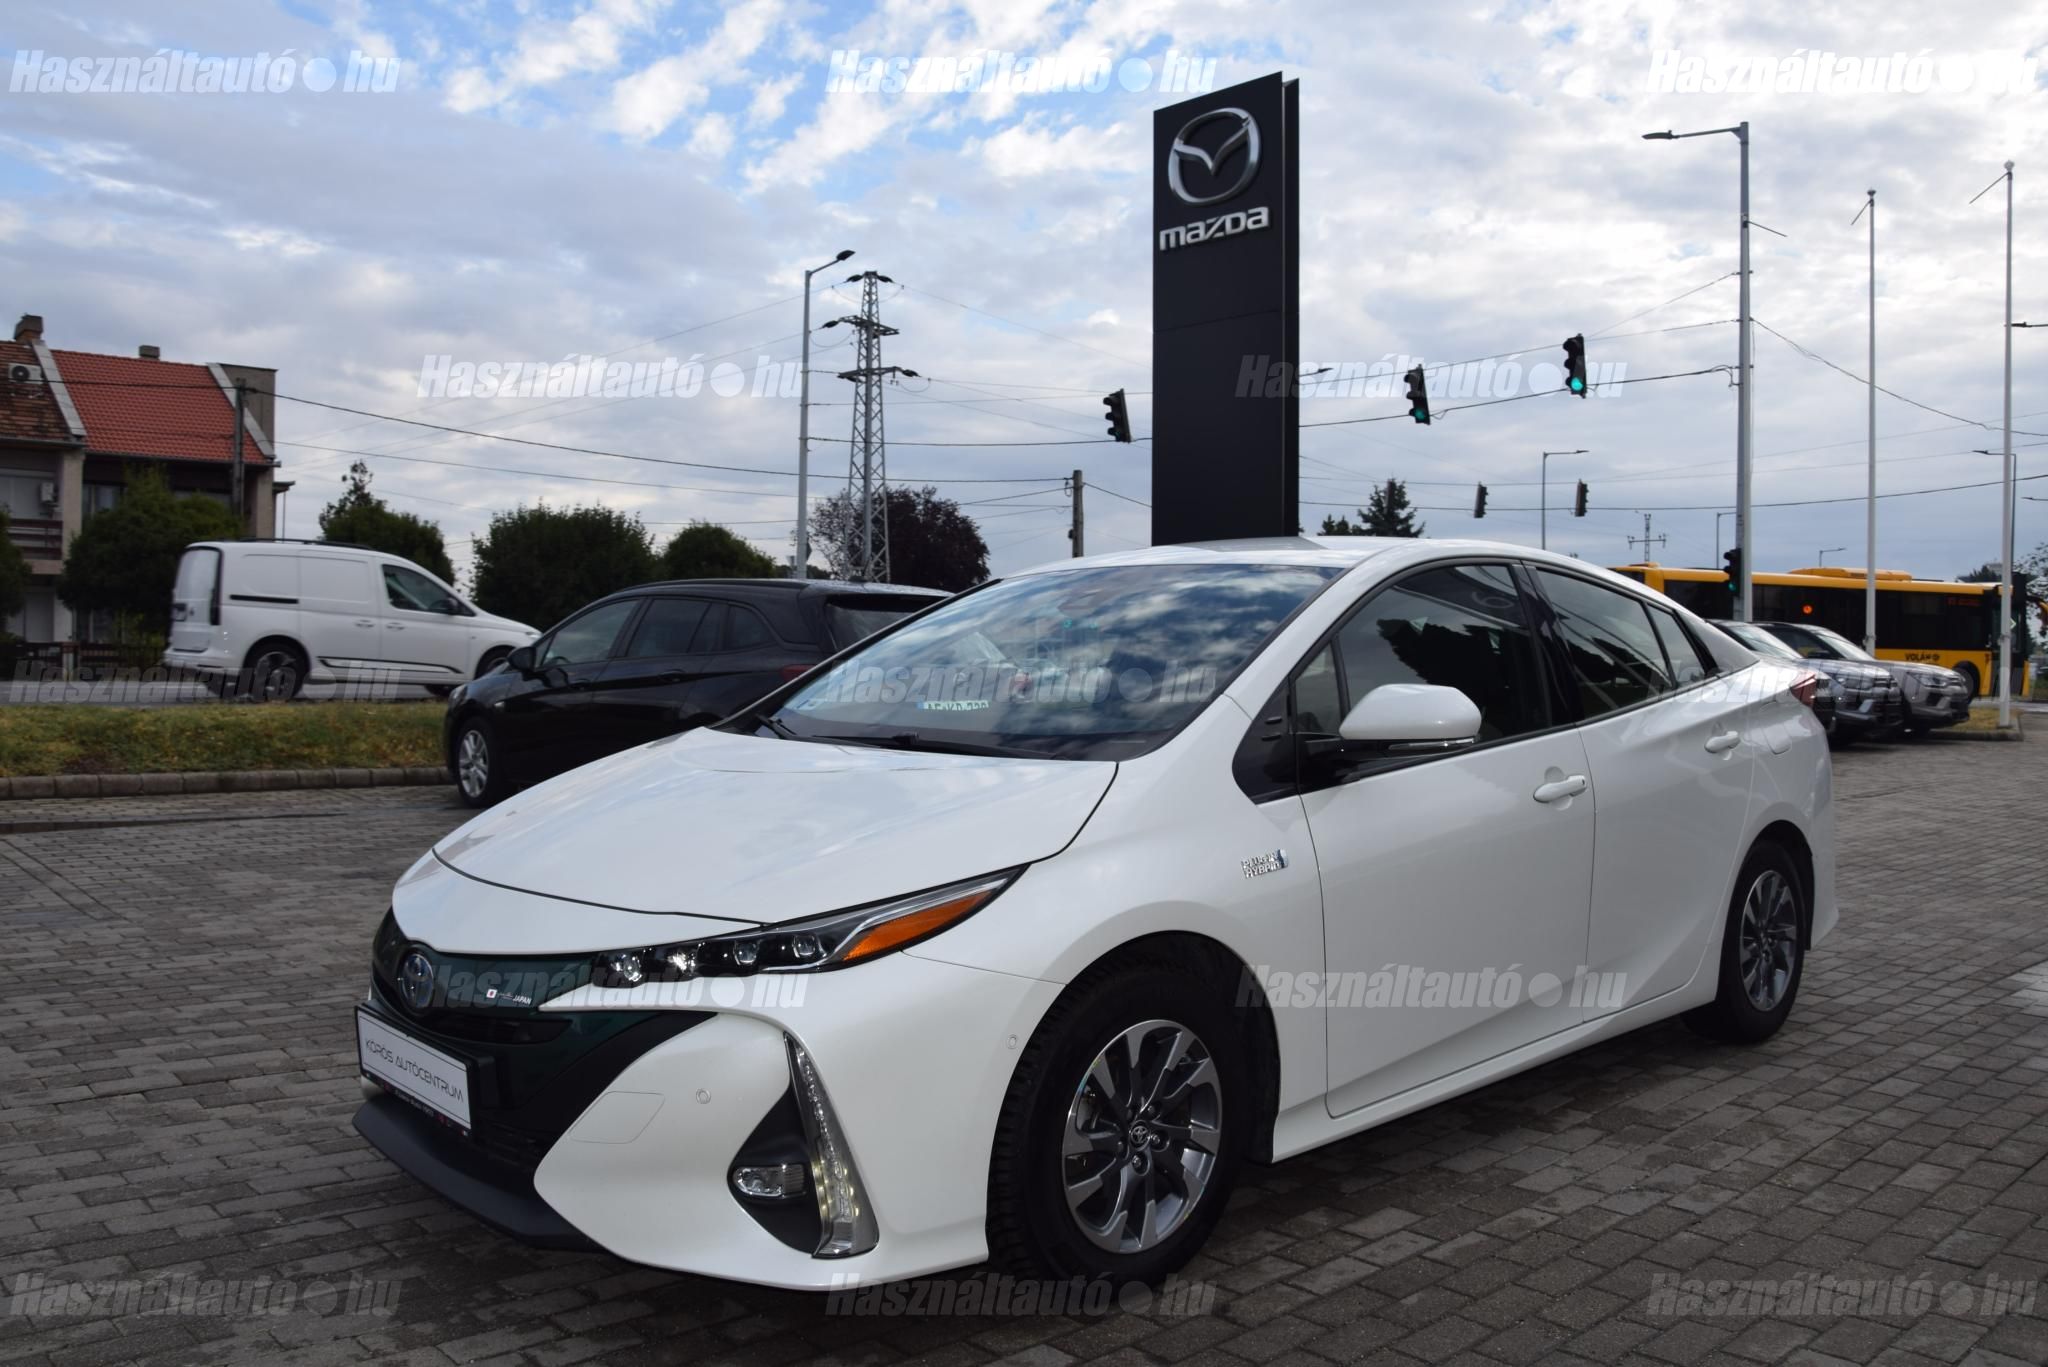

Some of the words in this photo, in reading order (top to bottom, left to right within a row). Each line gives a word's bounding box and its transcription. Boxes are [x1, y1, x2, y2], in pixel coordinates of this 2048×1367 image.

[1159, 206, 1269, 251] mazda
[512, 995, 531, 1005] JAPAN
[395, 1055, 464, 1103] AUTÓCENTRUM
